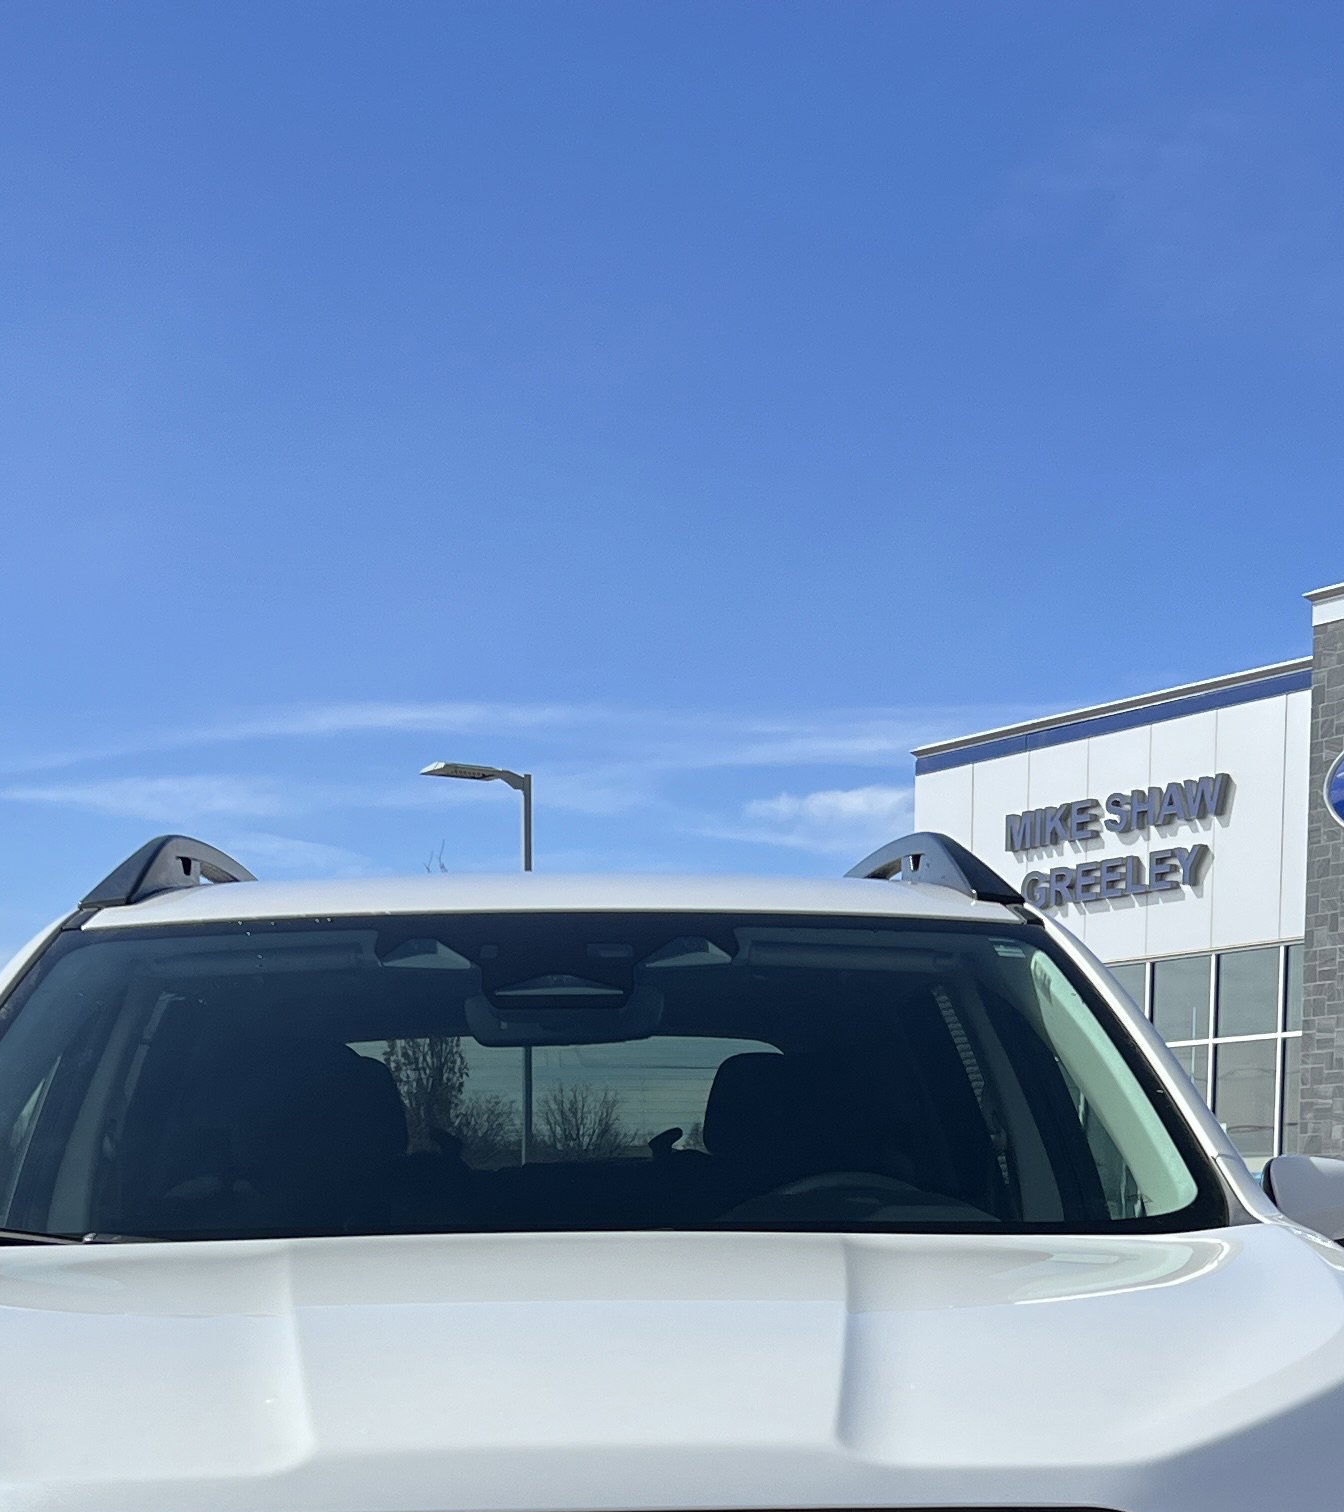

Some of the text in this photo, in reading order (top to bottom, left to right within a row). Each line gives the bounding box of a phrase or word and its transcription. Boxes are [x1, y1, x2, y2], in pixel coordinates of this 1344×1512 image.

[1005, 773, 1231, 851] MIKE SHAW
[1022, 844, 1210, 909] GREELEY
